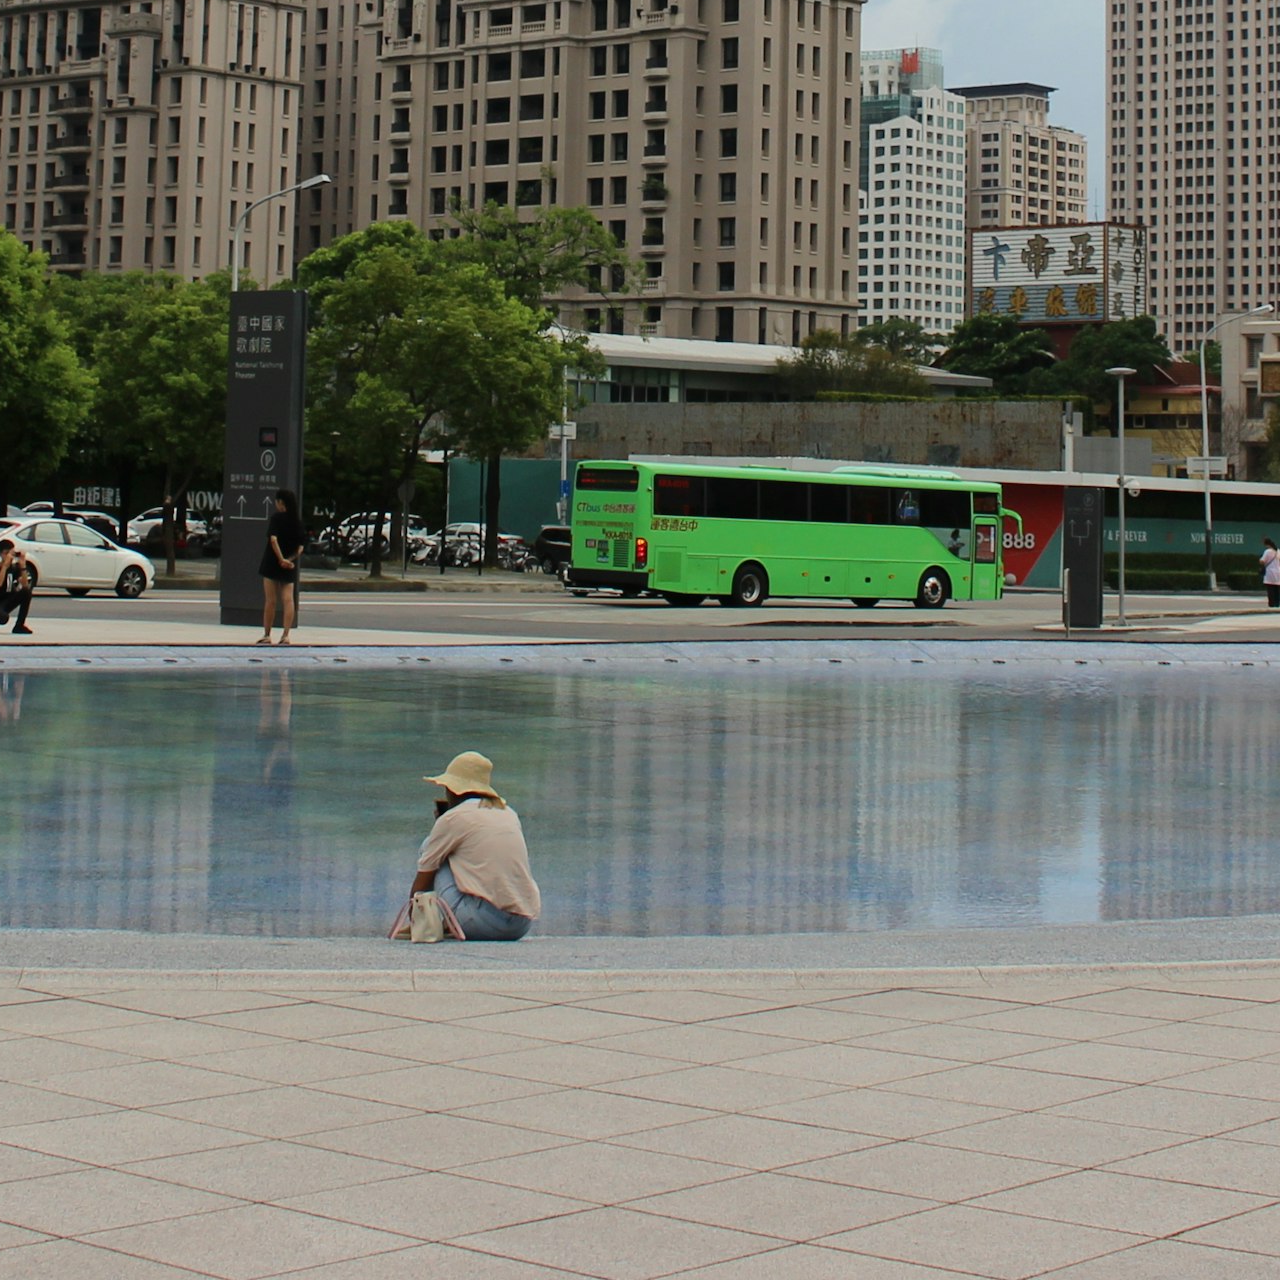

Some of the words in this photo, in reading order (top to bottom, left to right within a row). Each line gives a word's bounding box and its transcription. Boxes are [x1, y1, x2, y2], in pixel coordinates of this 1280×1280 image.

[237, 315, 286, 332] 臺中國家
[236, 337, 272, 353] 歌劇院
[186, 490, 224, 511] NOW
[576, 502, 600, 513] CTbus
[1115, 530, 1148, 542] FREVER
[1214, 533, 1244, 545] FOREVER
